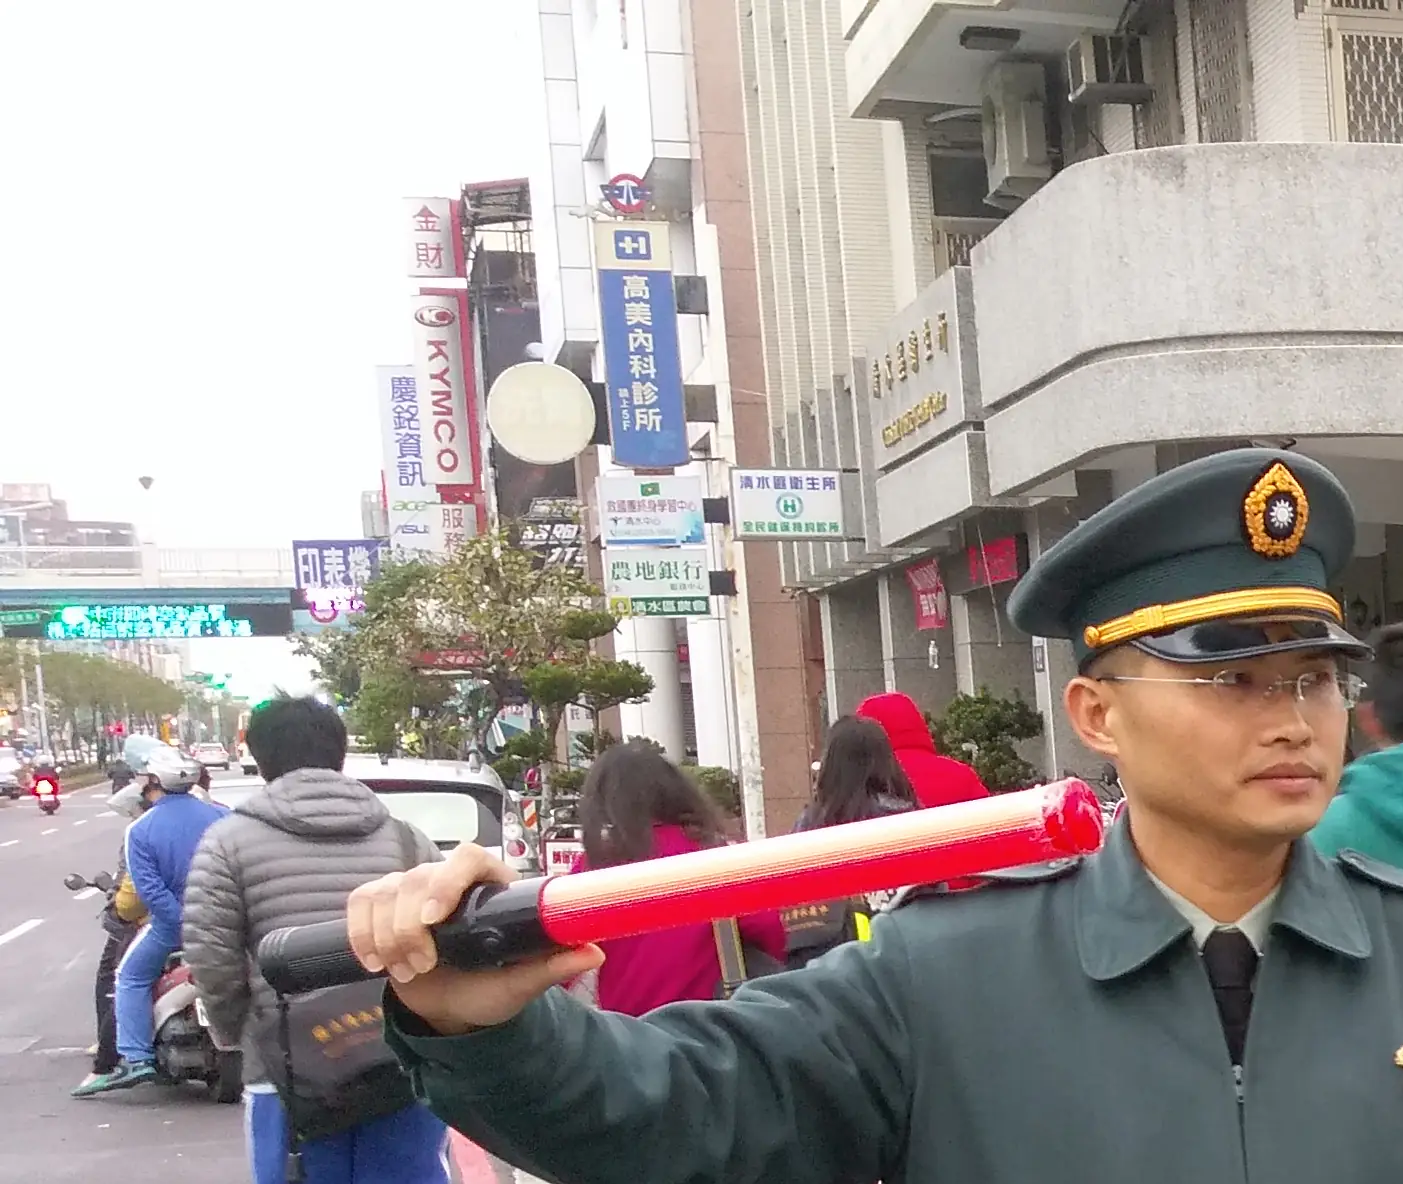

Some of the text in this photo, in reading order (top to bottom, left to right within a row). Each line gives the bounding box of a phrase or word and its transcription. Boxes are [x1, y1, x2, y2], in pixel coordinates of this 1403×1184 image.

[412, 204, 444, 269] 金財
[623, 275, 663, 432] 高美內科診所
[391, 376, 426, 486] 慶銘資訊
[426, 340, 459, 473] KYMCO
[392, 500, 428, 512] ace
[740, 475, 836, 491] 清水區衛生所
